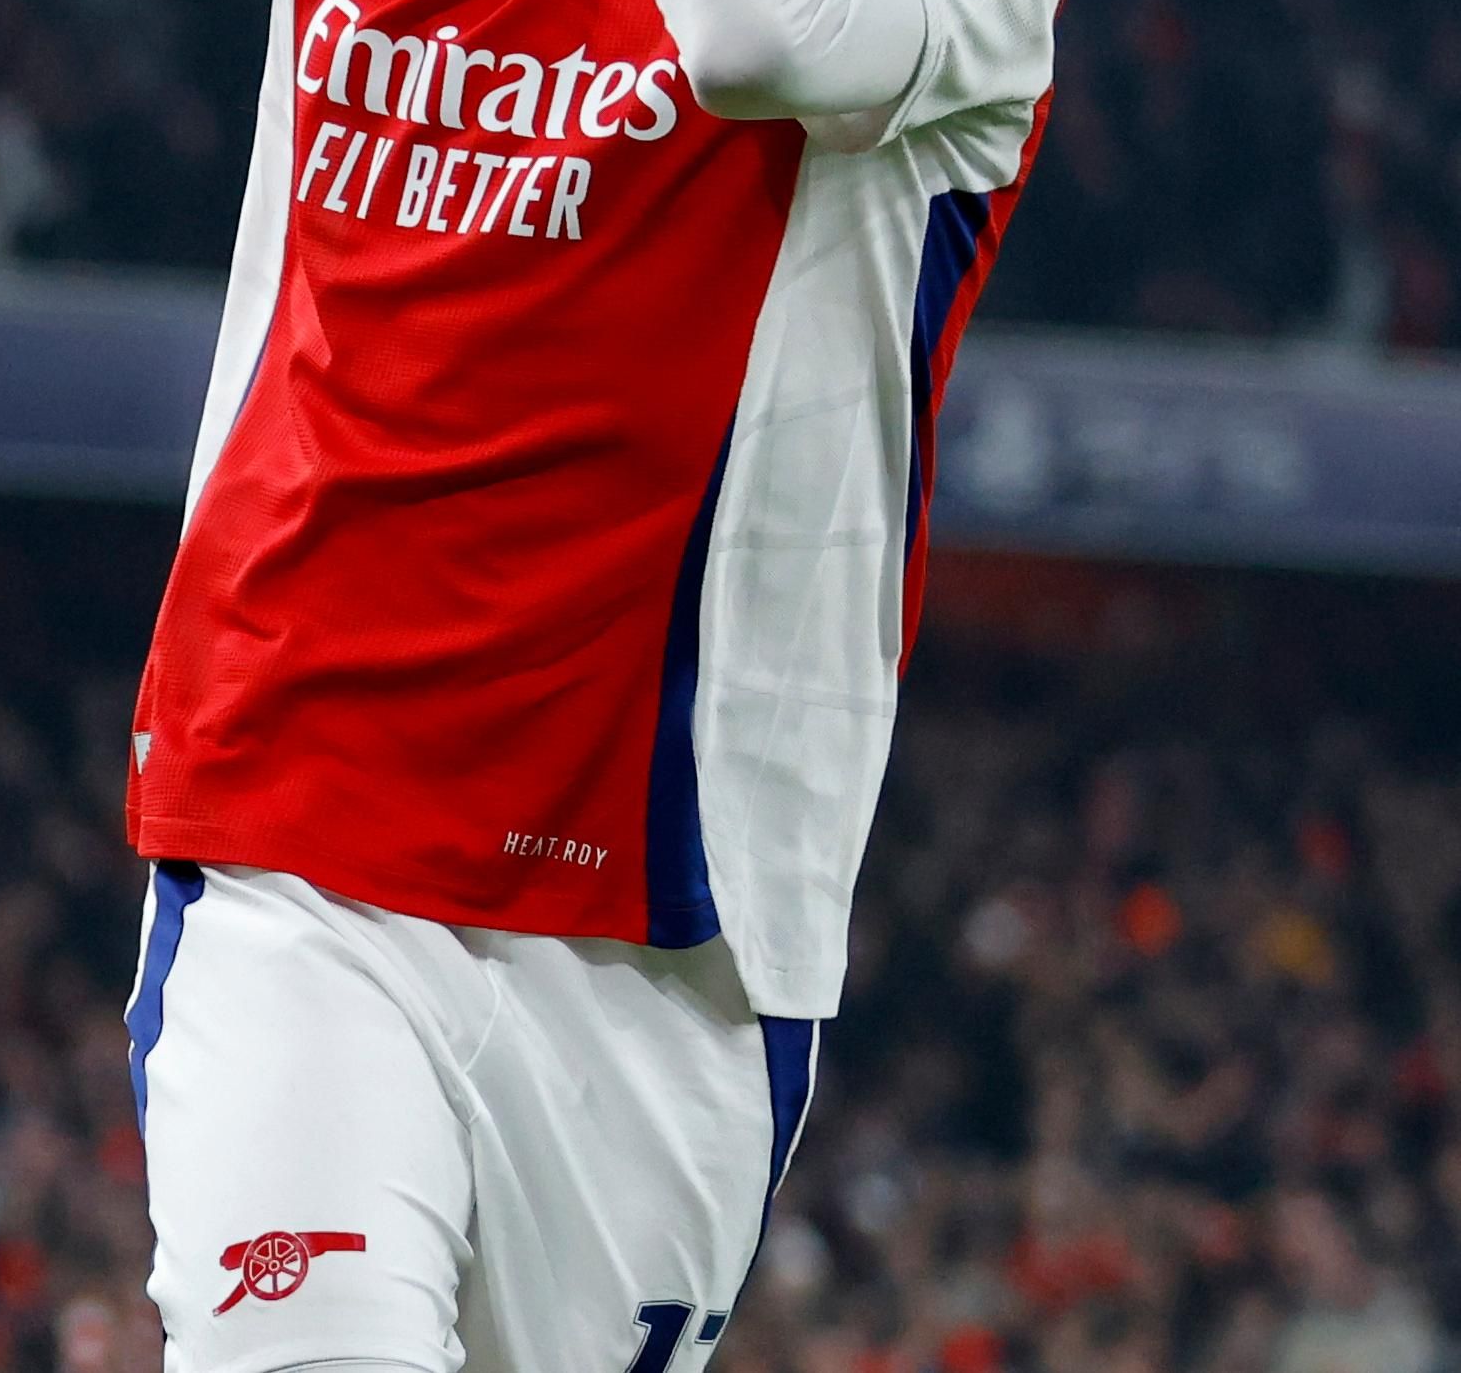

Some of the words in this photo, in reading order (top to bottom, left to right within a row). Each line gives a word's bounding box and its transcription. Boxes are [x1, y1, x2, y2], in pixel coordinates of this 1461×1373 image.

[297, 121, 395, 220] FLY
[395, 143, 592, 241] BETTER
[503, 830, 608, 871] HEAT.RDY
